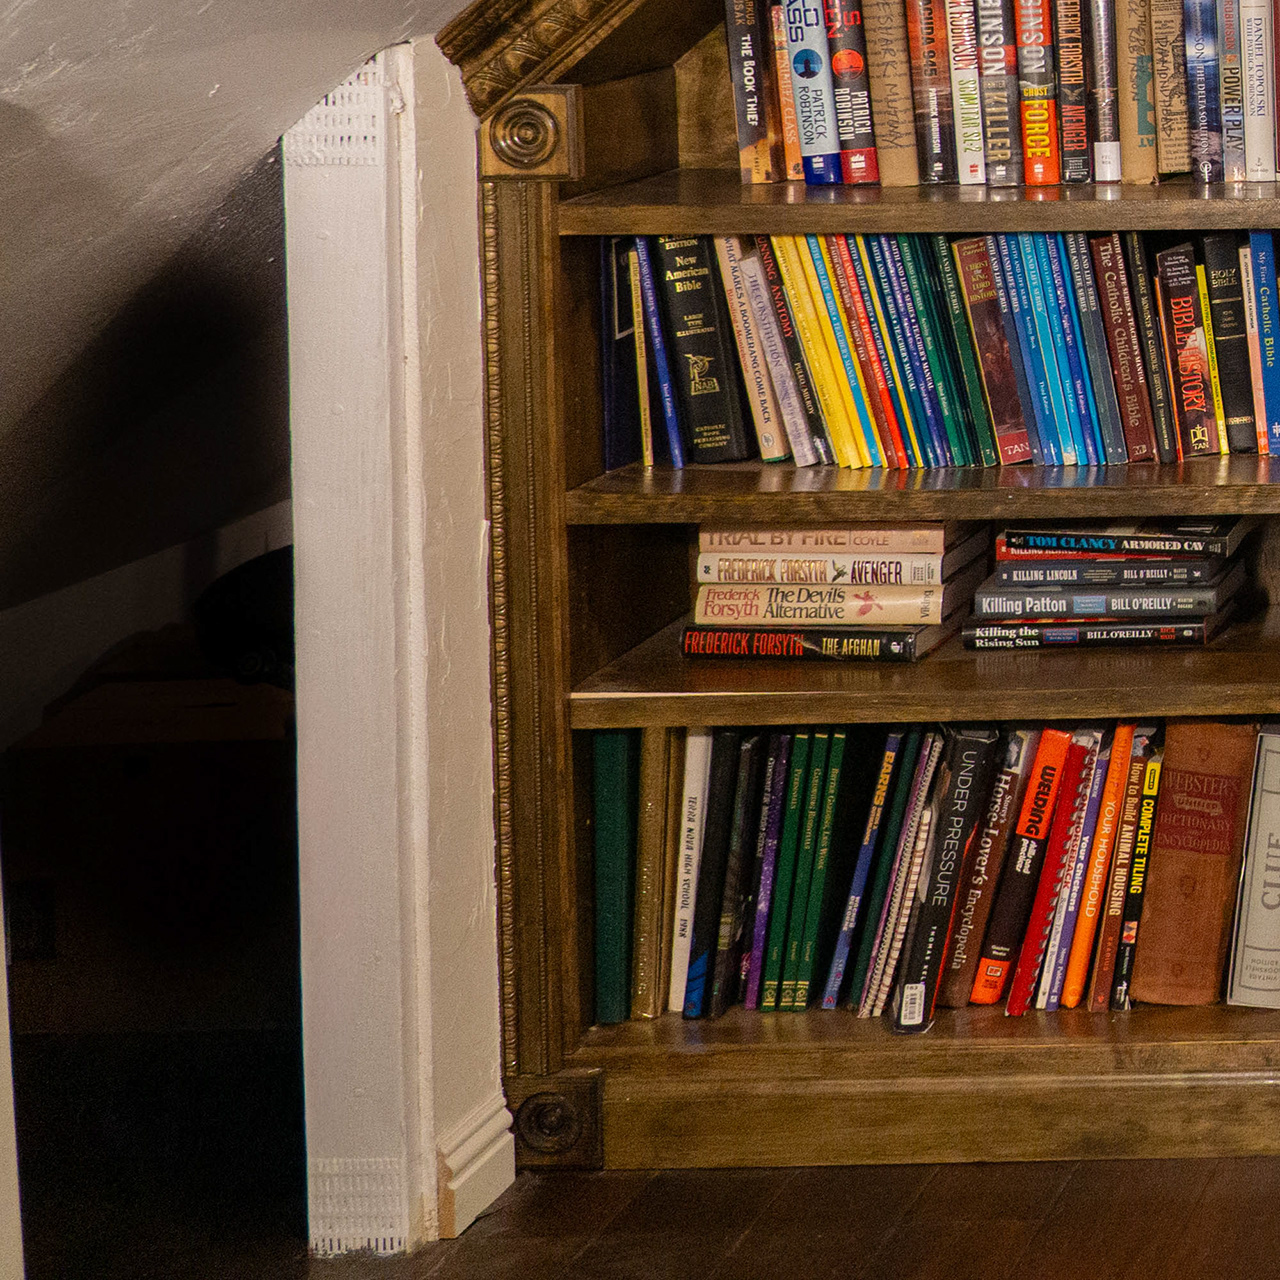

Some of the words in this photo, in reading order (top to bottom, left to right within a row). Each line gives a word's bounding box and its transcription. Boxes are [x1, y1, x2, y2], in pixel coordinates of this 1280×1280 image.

[1061, 42, 1083, 85] FORSYTH
[958, 79, 983, 129] SCIMITAR
[1062, 104, 1087, 150] AVENGER
[963, 131, 985, 153] SL-2
[1257, 251, 1267, 264] My
[1258, 266, 1268, 284] First
[1259, 286, 1273, 334] Catholic
[1263, 337, 1275, 367] Bible
[1026, 536, 1053, 548] TOM
[1056, 538, 1119, 550] CLANCY
[1120, 539, 1179, 551] ARMORED
[1181, 540, 1205, 552] CAV
[766, 587, 790, 603] The
[793, 587, 845, 603] Devil's
[762, 601, 845, 619] Alternative
[1026, 765, 1057, 836] WELDING
